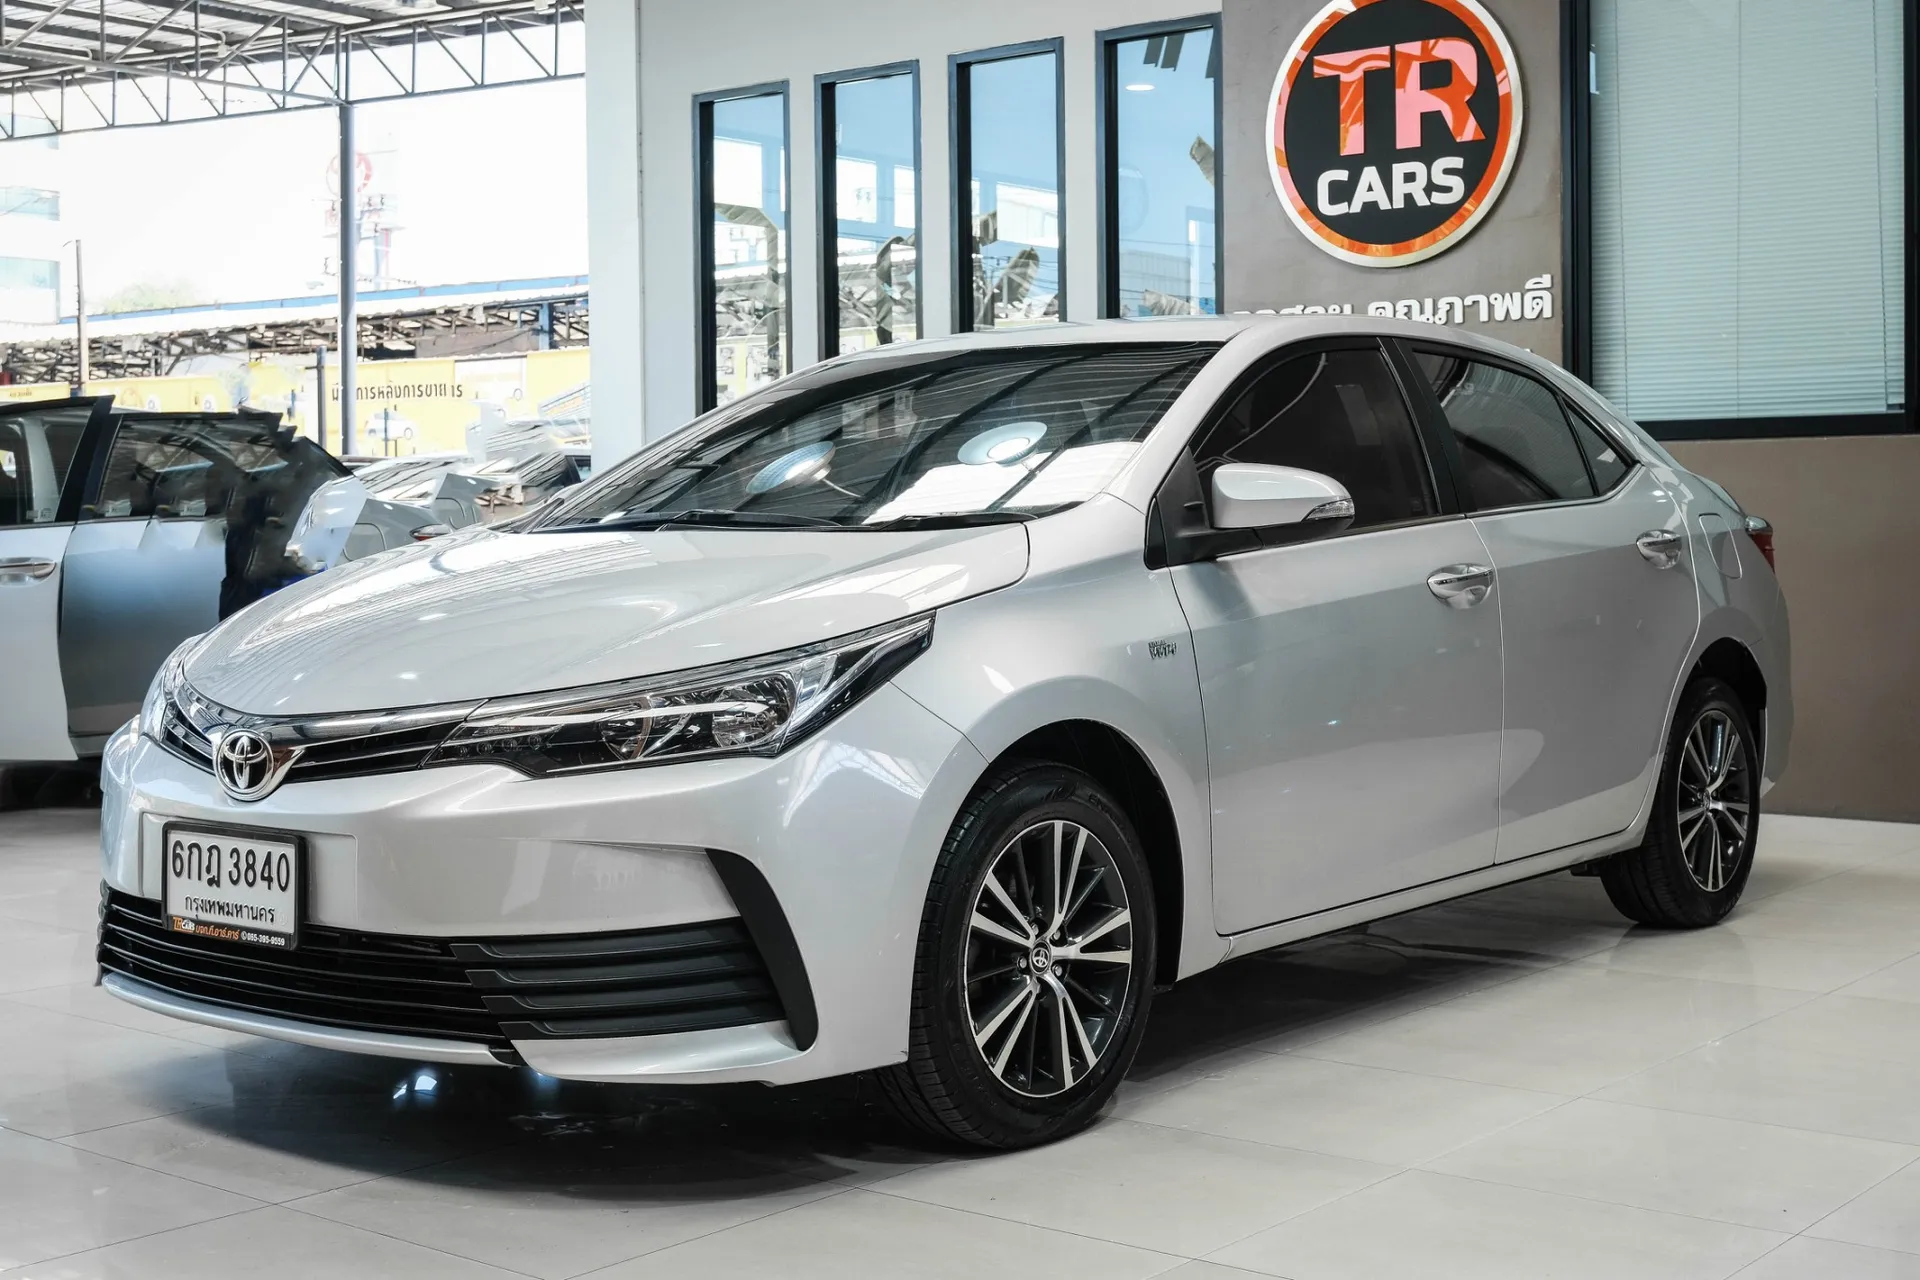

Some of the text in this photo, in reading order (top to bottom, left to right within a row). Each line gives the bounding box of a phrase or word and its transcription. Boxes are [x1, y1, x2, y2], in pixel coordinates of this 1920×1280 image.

[1313, 37, 1487, 156] TR
[1316, 156, 1466, 217] CARS
[1367, 273, 1554, 325] คณภาพดี
[172, 839, 290, 892] 6กฎ 3840
[185, 896, 276, 924] กรุงเทพมหานคร
